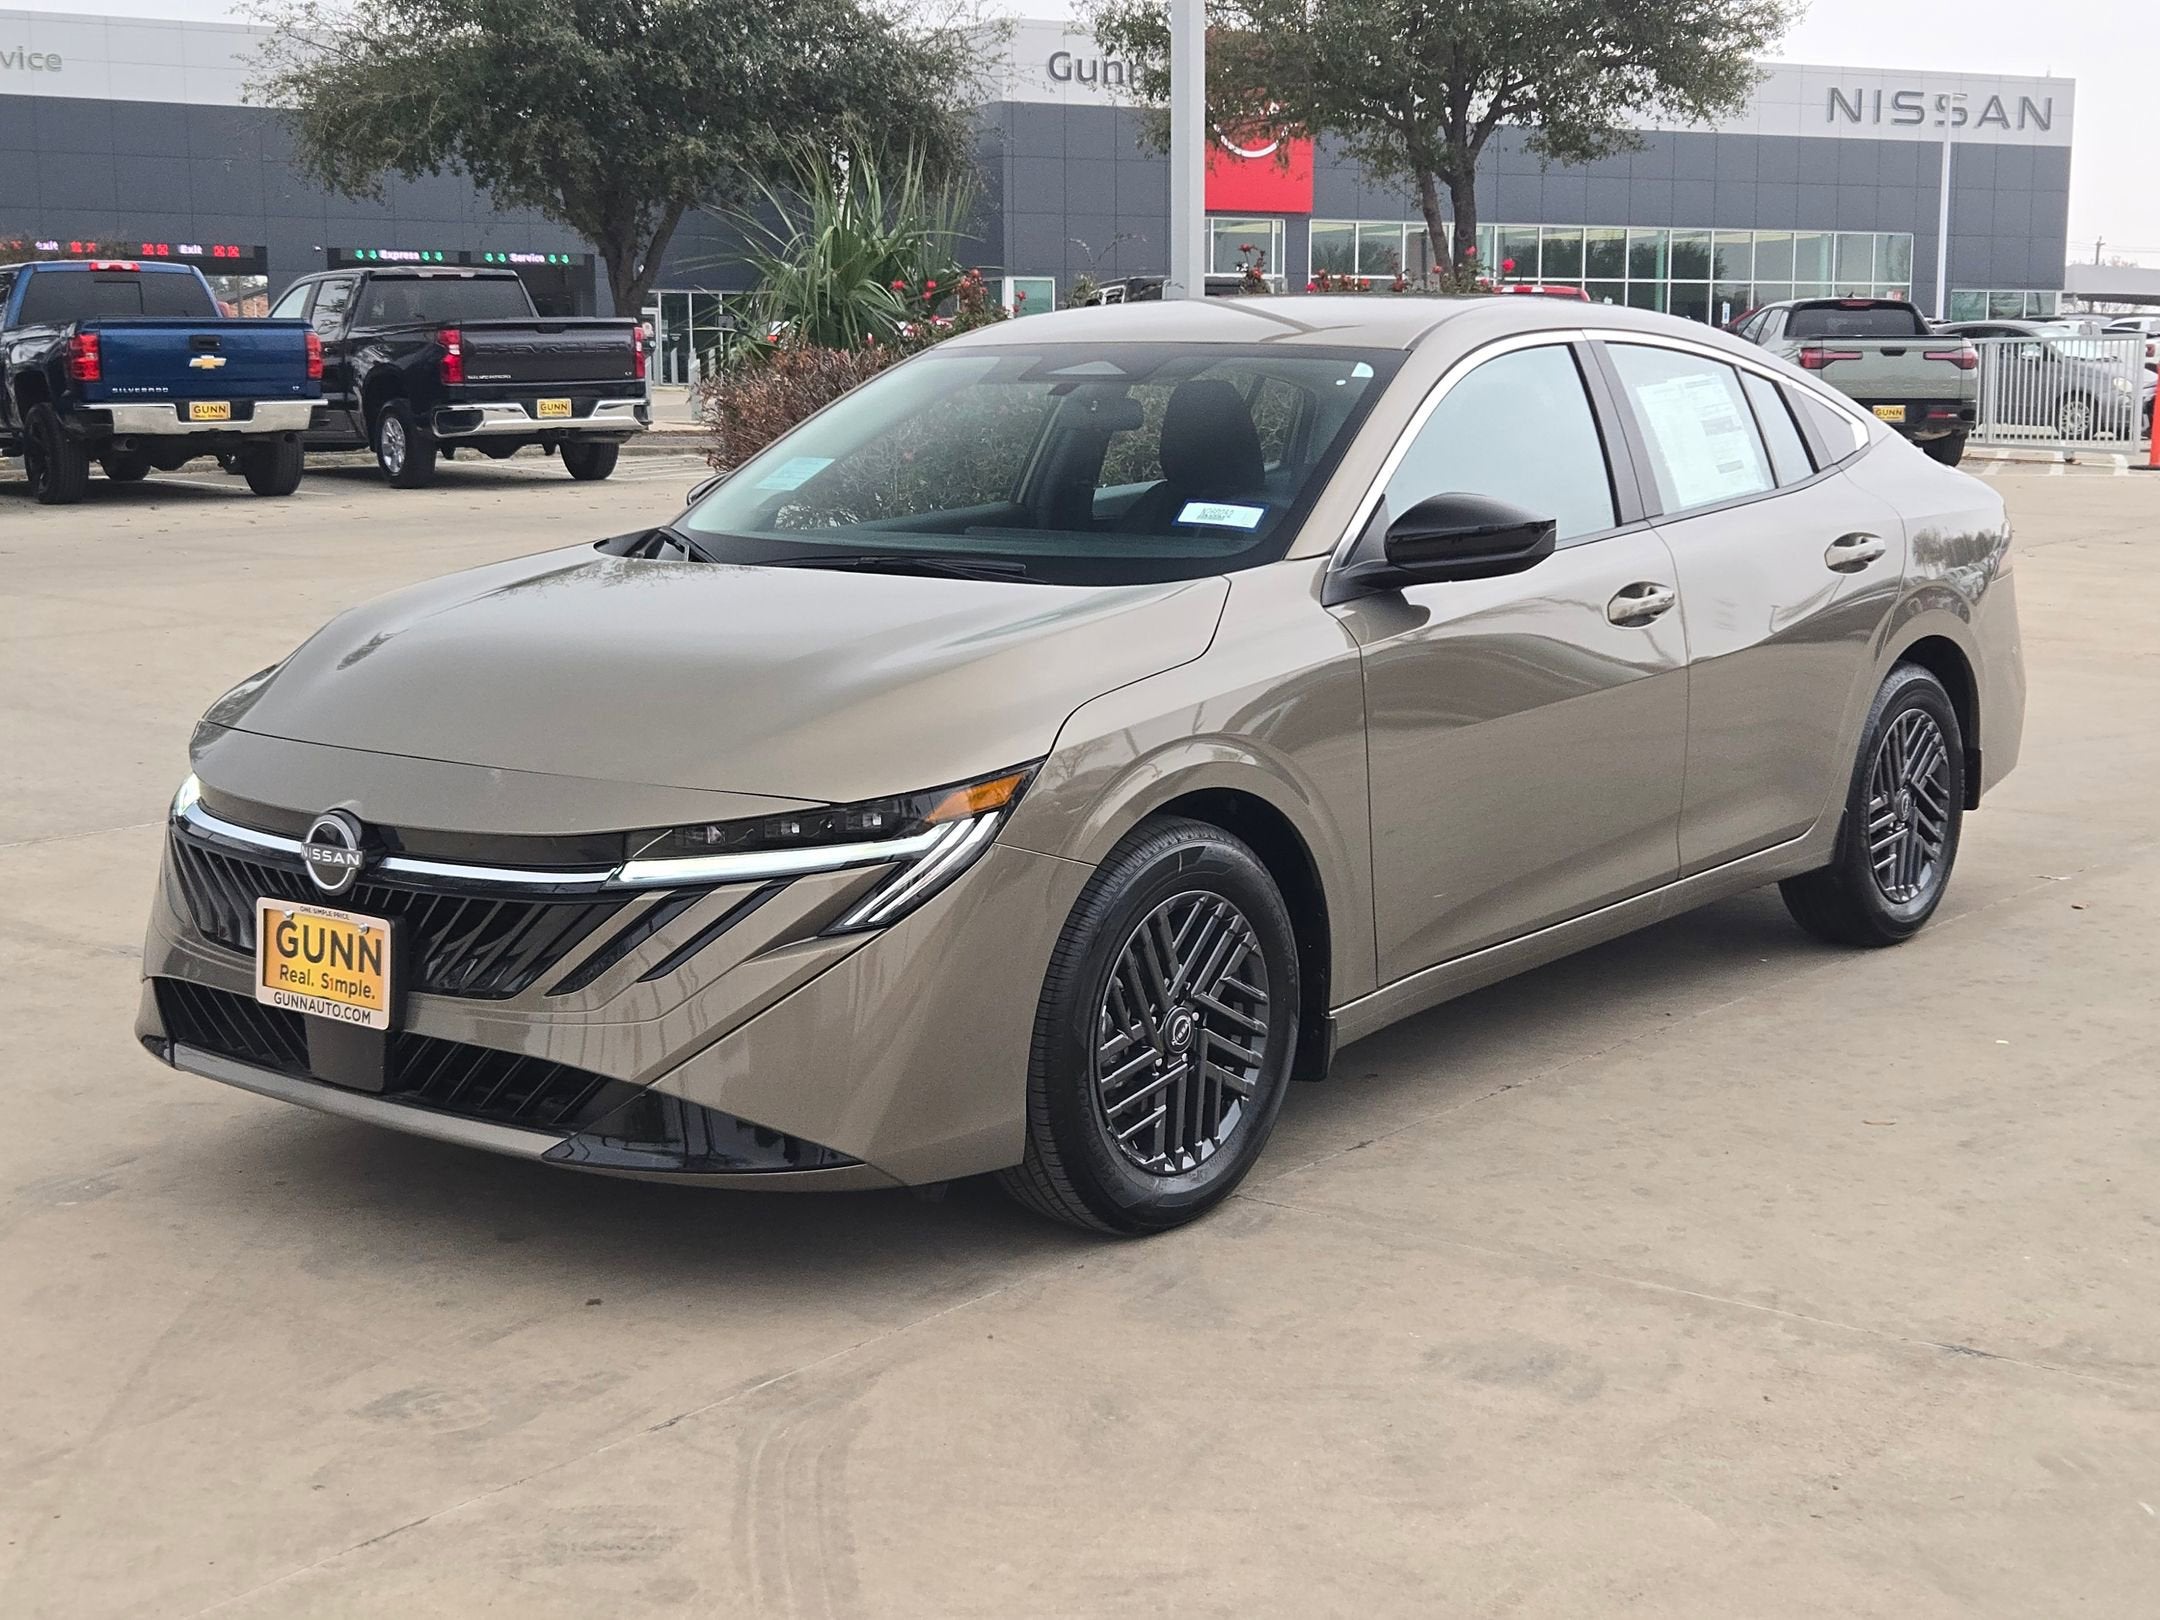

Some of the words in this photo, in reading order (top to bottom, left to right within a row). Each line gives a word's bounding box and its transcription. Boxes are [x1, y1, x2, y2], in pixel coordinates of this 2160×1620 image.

[1827, 87, 2053, 131] NISSAN
[179, 244, 203, 255] Exit
[379, 249, 420, 261] Express
[509, 253, 546, 263] Service
[193, 405, 226, 414] GUNN
[540, 403, 568, 411] GUNN
[301, 845, 360, 866] NISSAN
[276, 920, 382, 977] GUNN
[280, 963, 315, 987] Real.
[273, 991, 371, 1025] GUNNAUTO.COM
